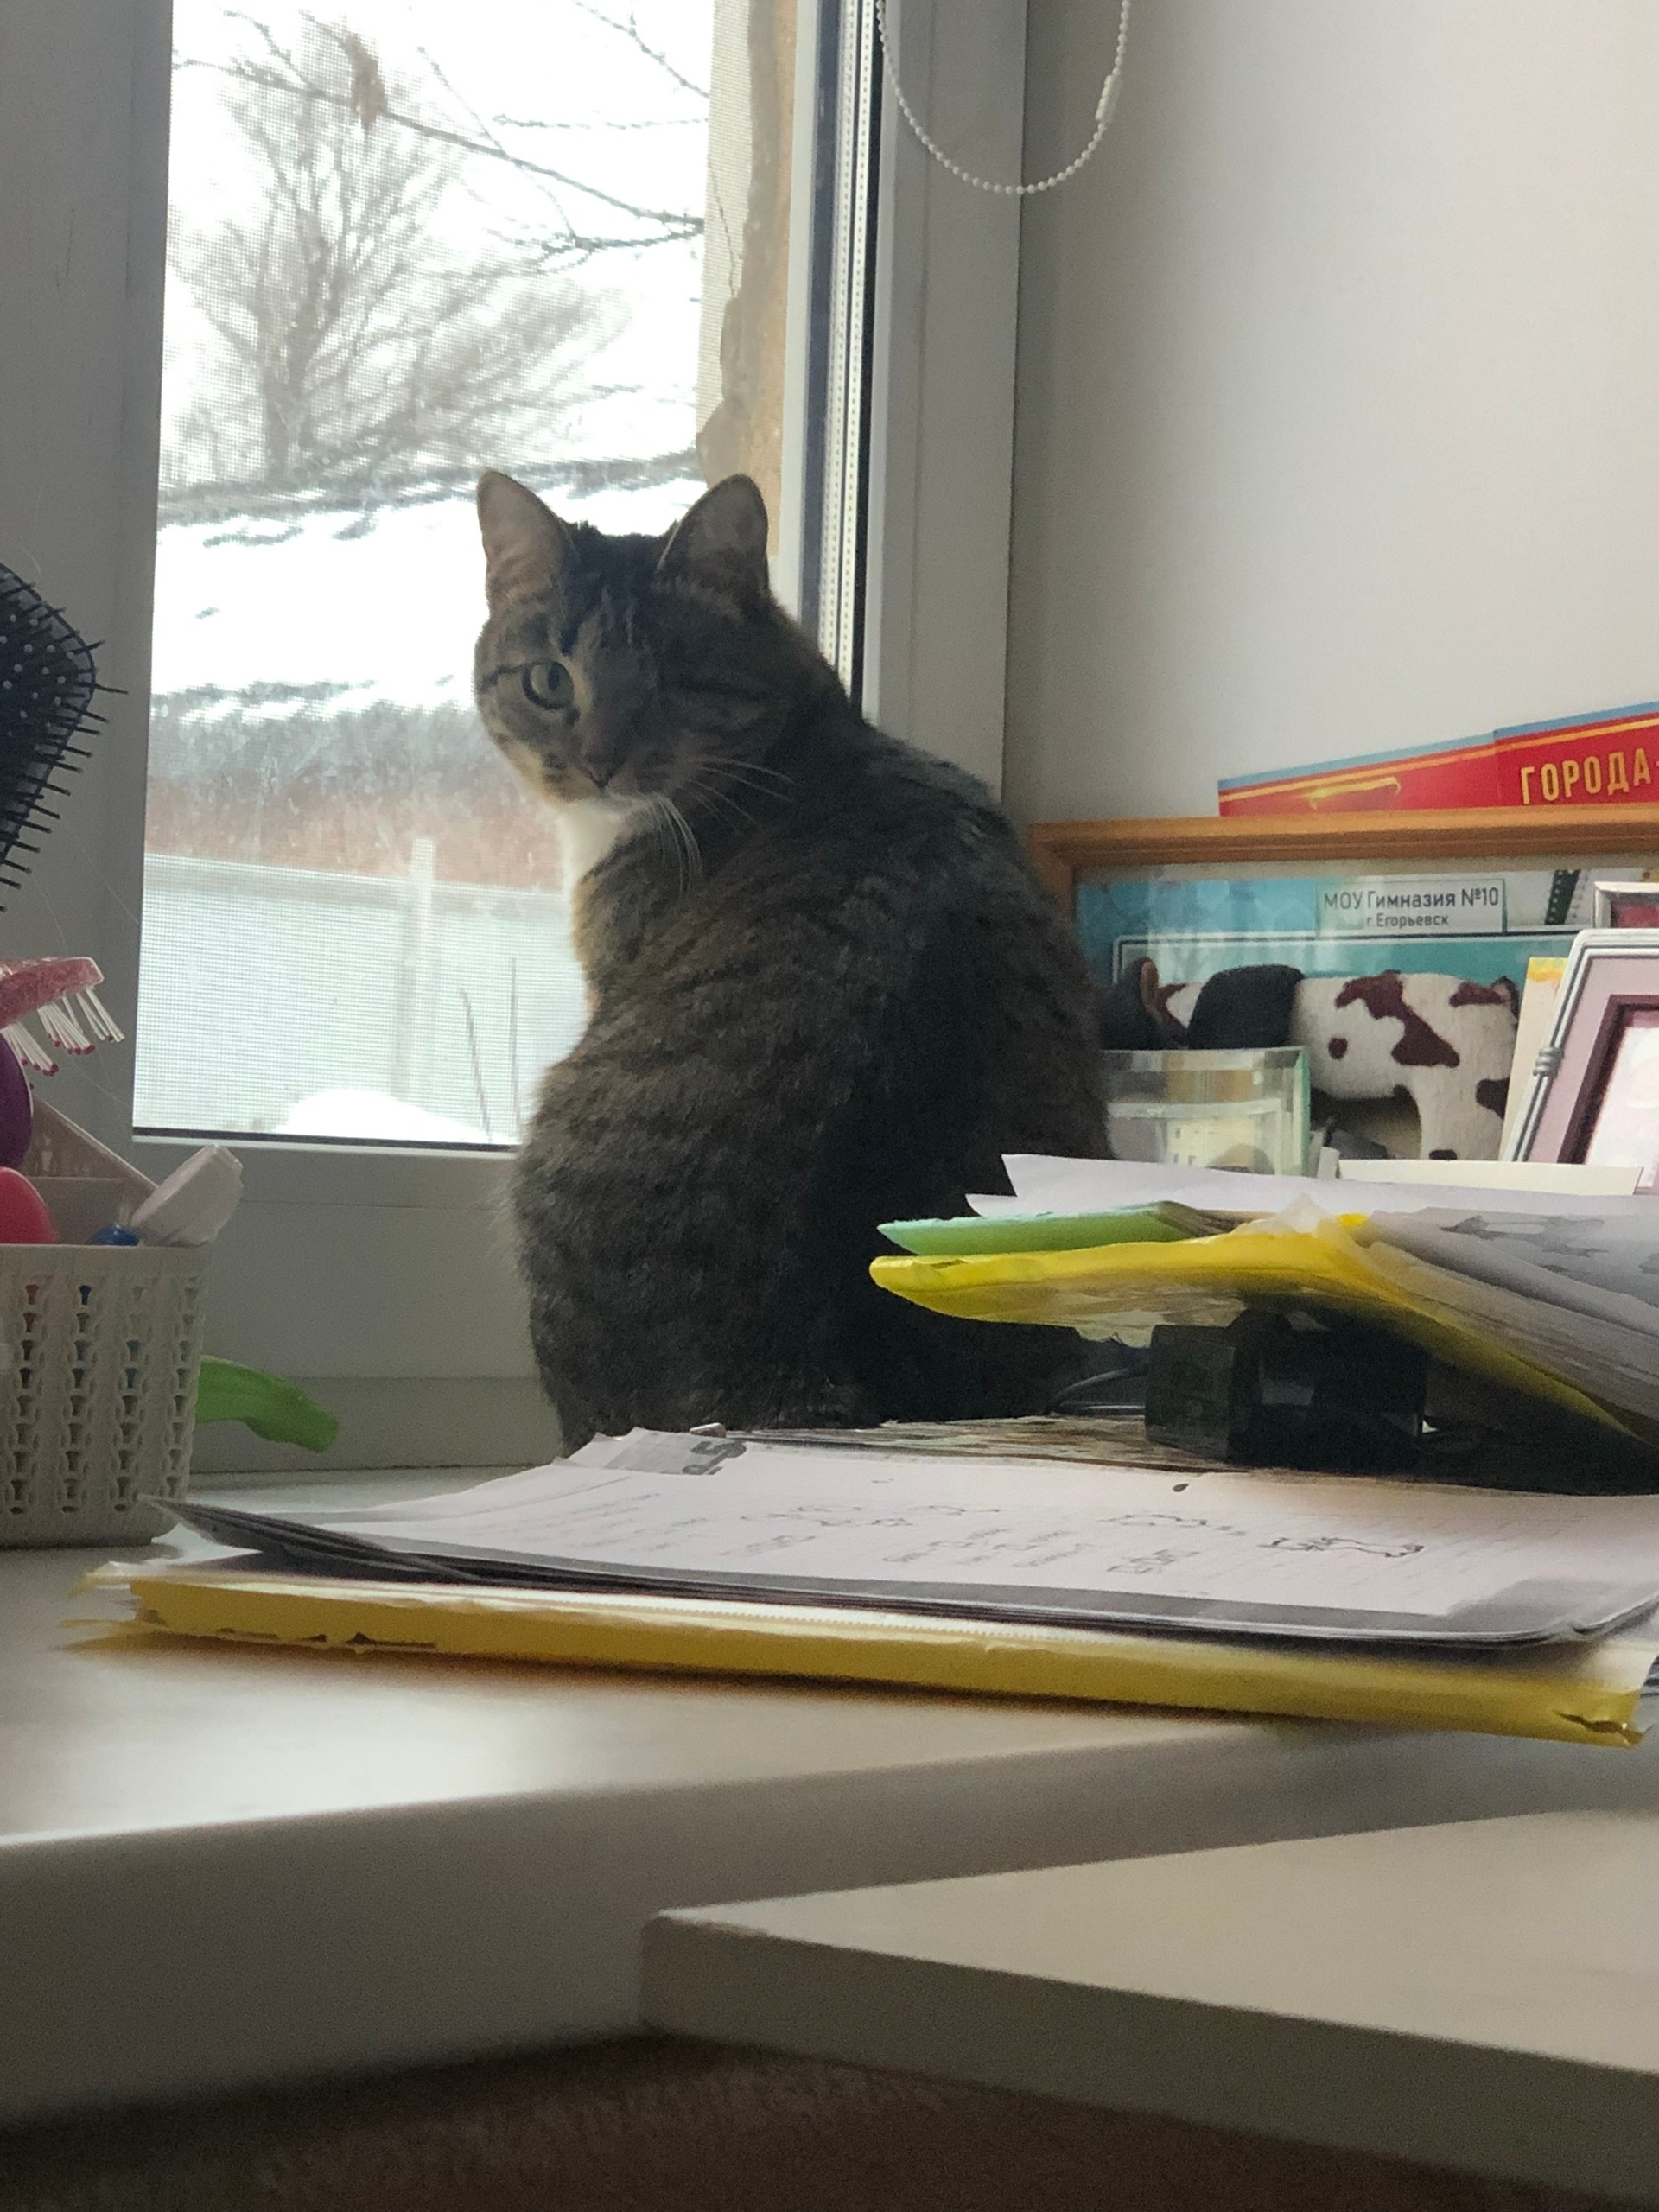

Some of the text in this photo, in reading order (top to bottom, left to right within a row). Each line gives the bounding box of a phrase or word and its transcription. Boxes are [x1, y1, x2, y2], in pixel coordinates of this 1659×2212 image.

[1323, 887, 1499, 910] МОУ Гимназия №10
